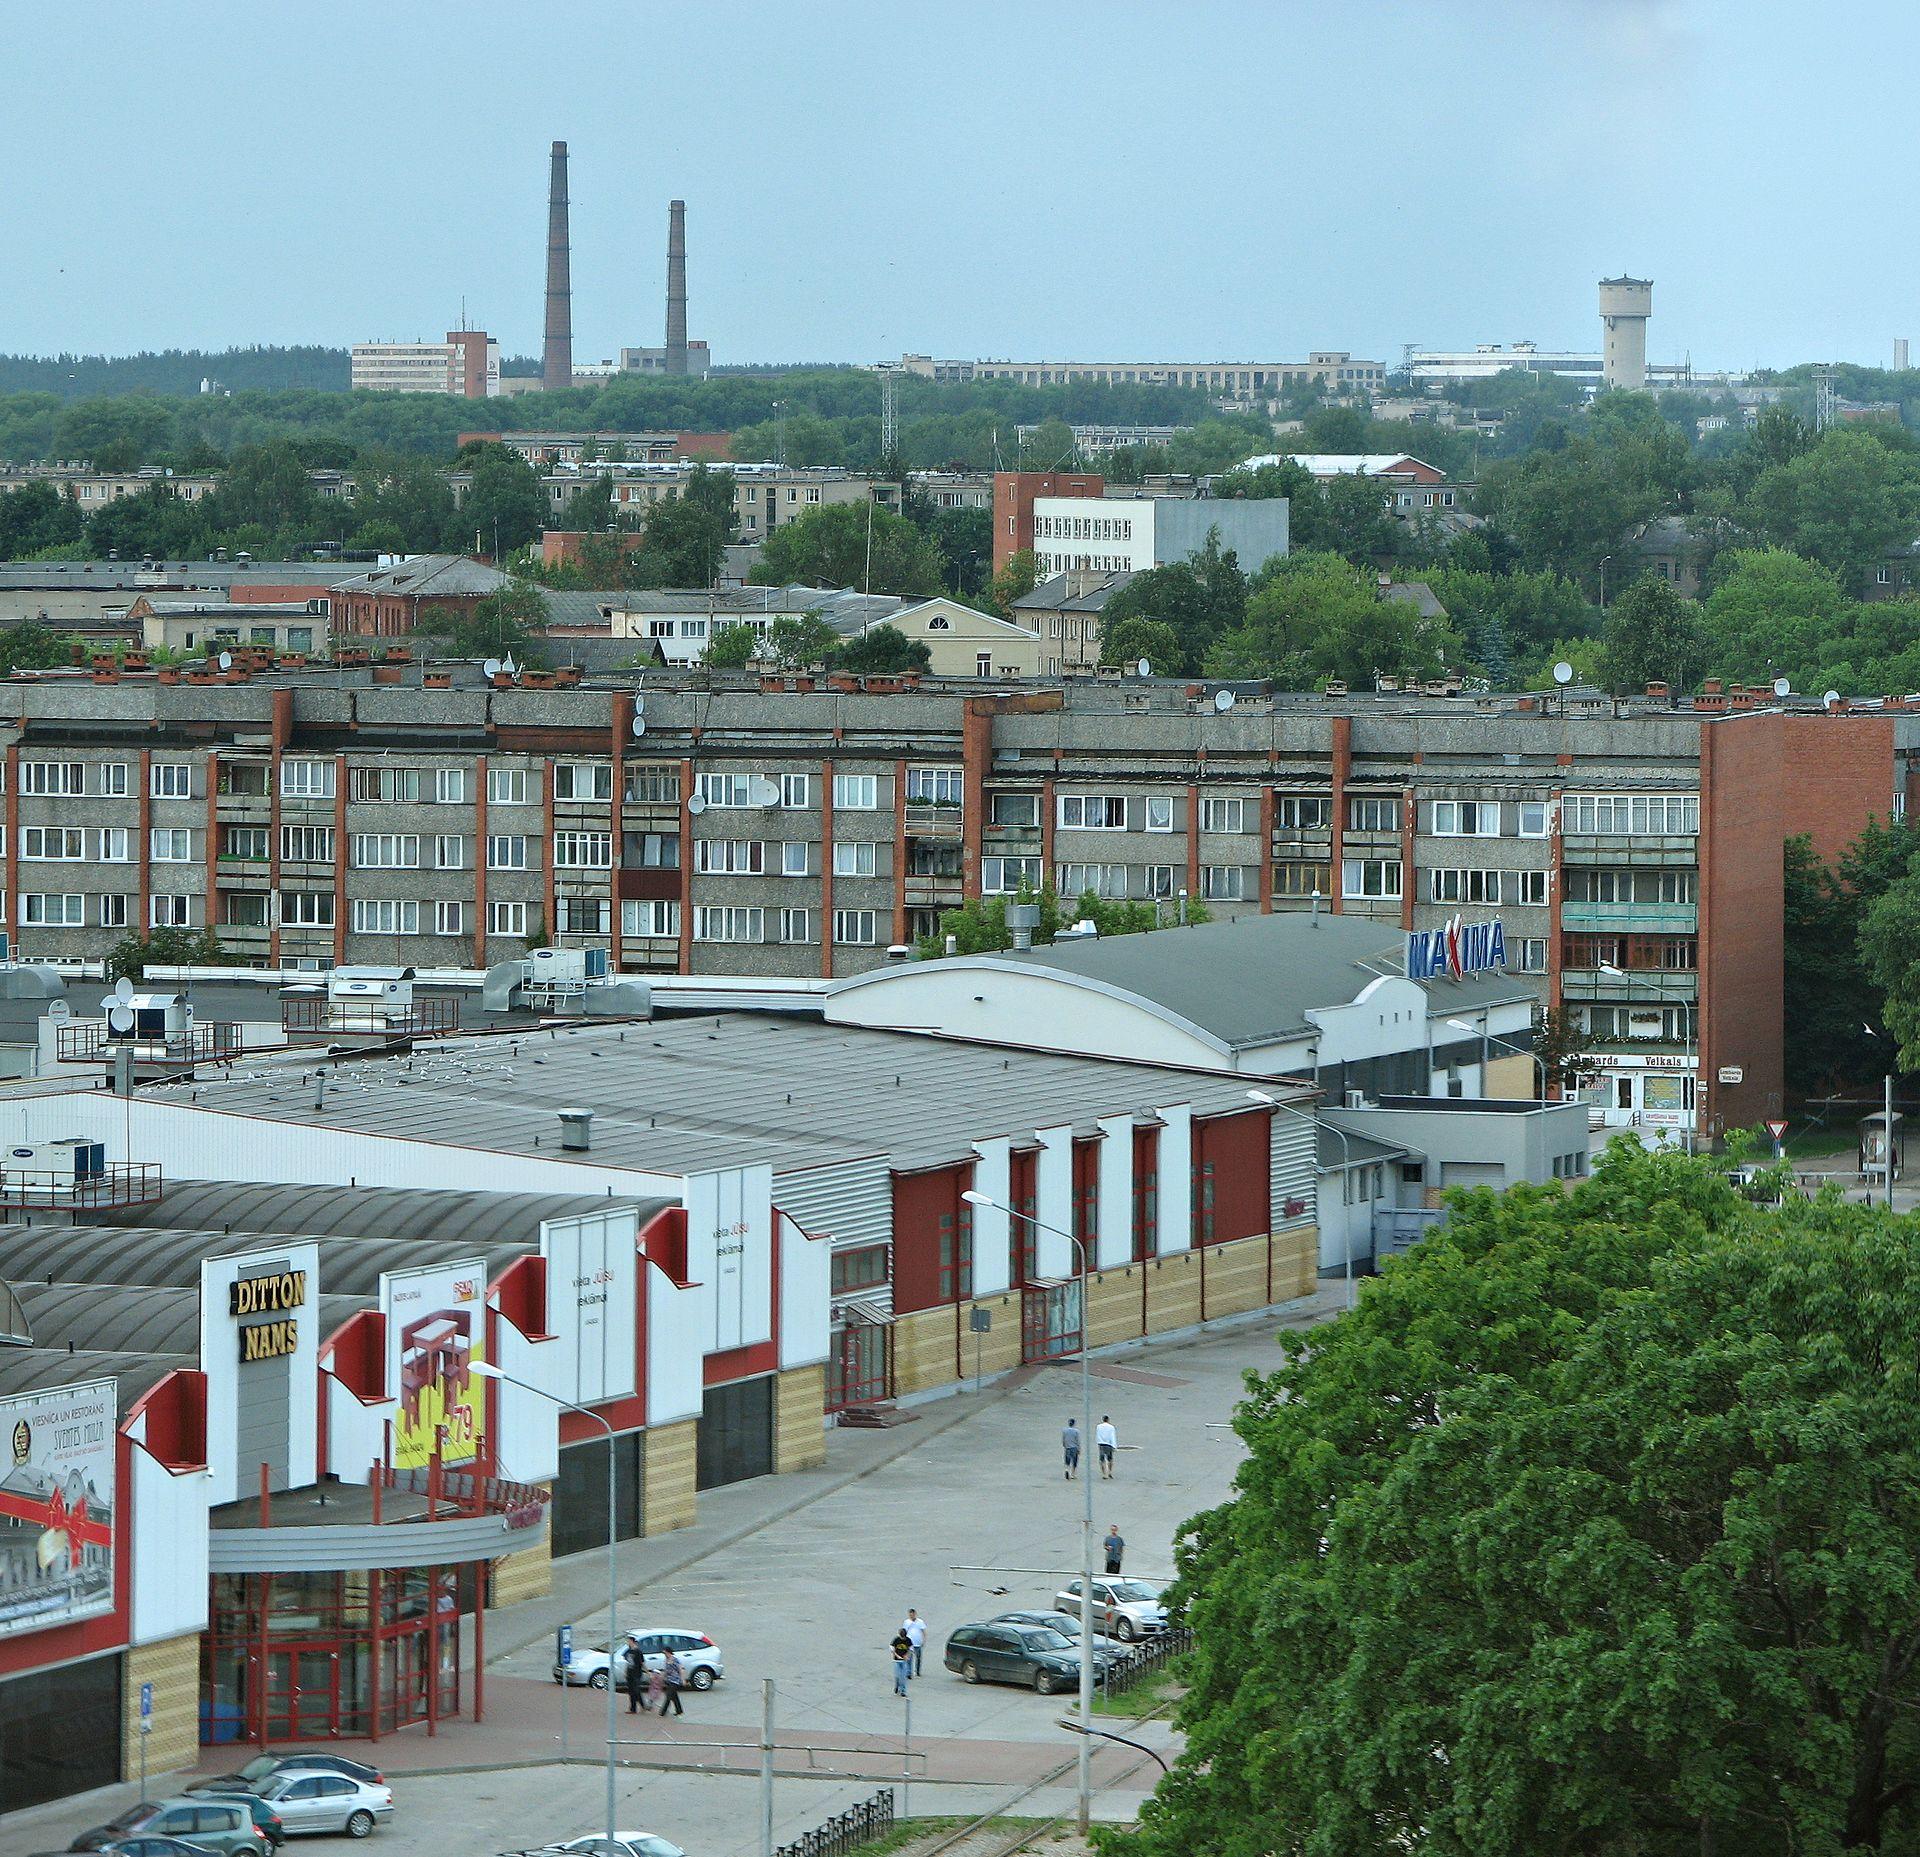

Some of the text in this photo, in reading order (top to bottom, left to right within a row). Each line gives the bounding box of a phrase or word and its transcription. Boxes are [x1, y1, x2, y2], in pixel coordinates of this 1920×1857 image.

[1409, 914, 1506, 981] MAXIMA
[237, 1271, 305, 1314] DITTON
[244, 1320, 298, 1361] NAMS
[453, 1404, 472, 1442] 79
